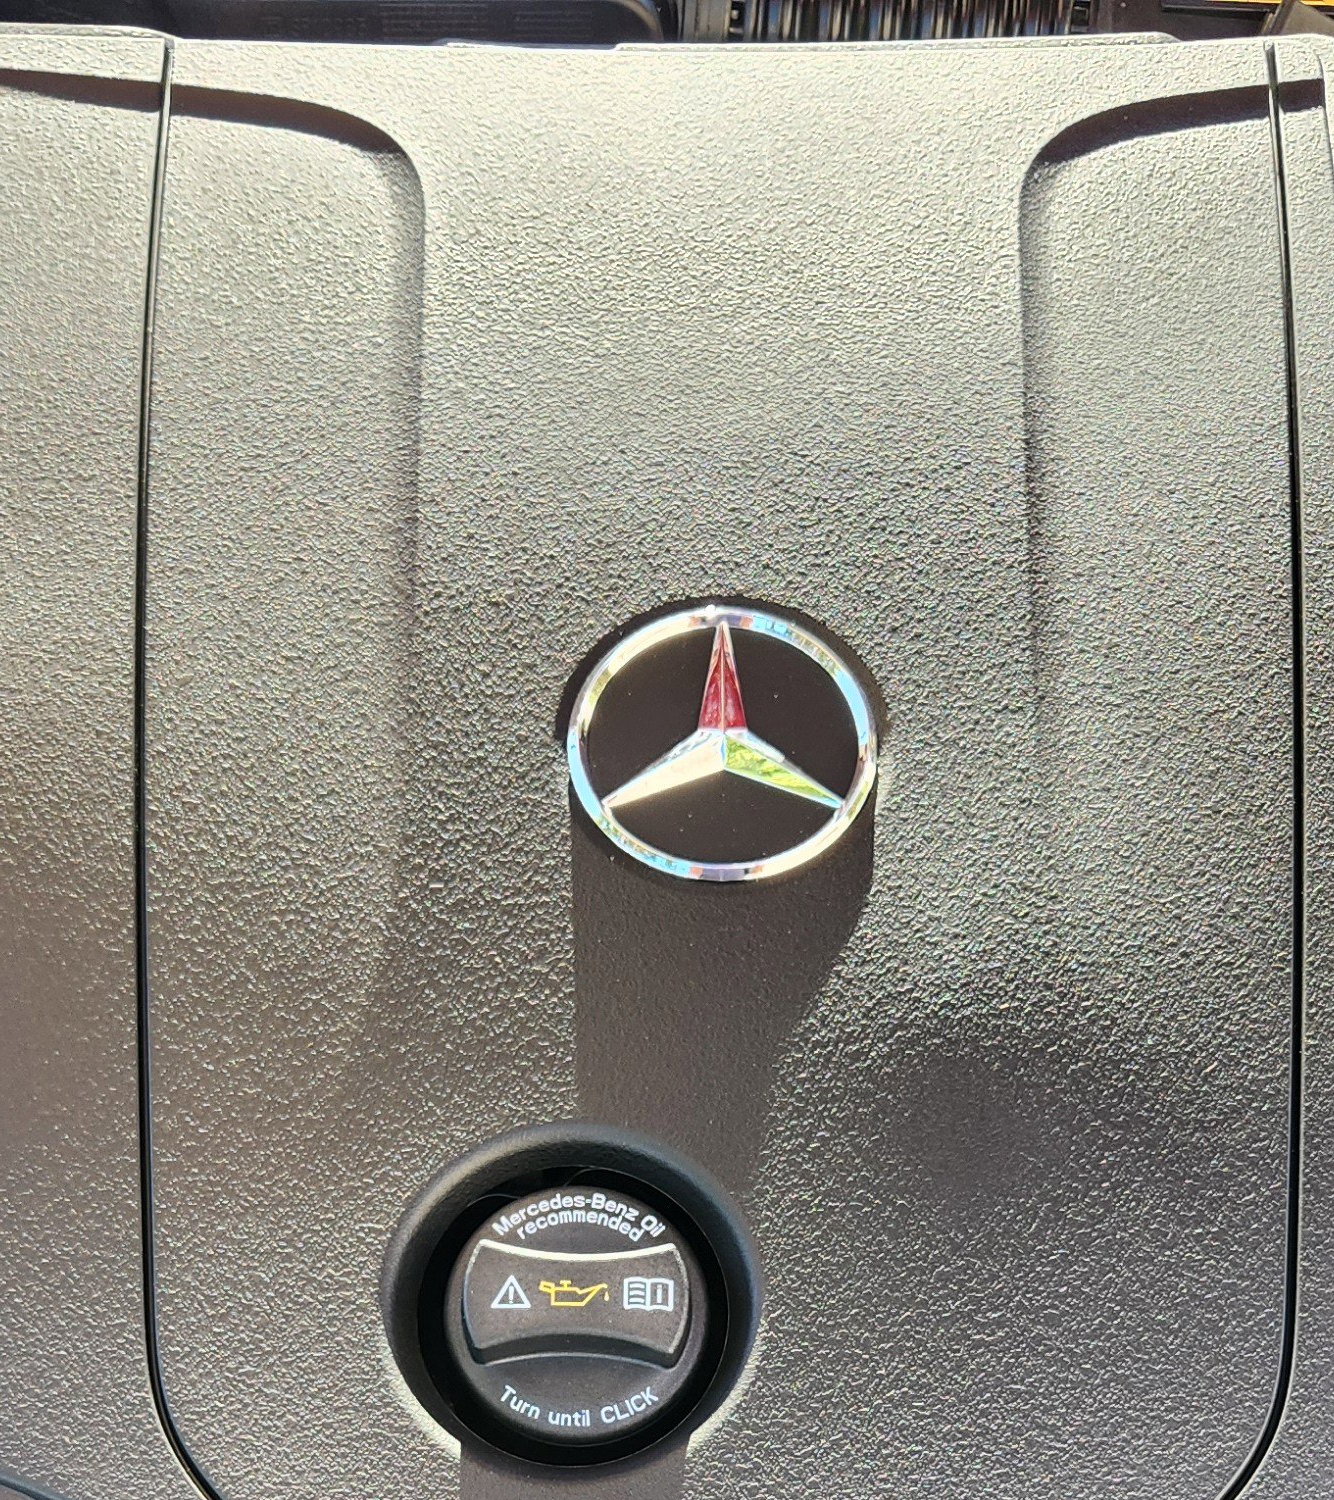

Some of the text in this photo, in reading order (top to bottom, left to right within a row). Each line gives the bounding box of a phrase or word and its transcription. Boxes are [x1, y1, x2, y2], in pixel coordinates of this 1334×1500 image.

[492, 1192, 666, 1238] Mercedes-Benz Oil
[517, 1209, 645, 1242] recommended
[500, 1384, 659, 1427] Turn until CLICK
